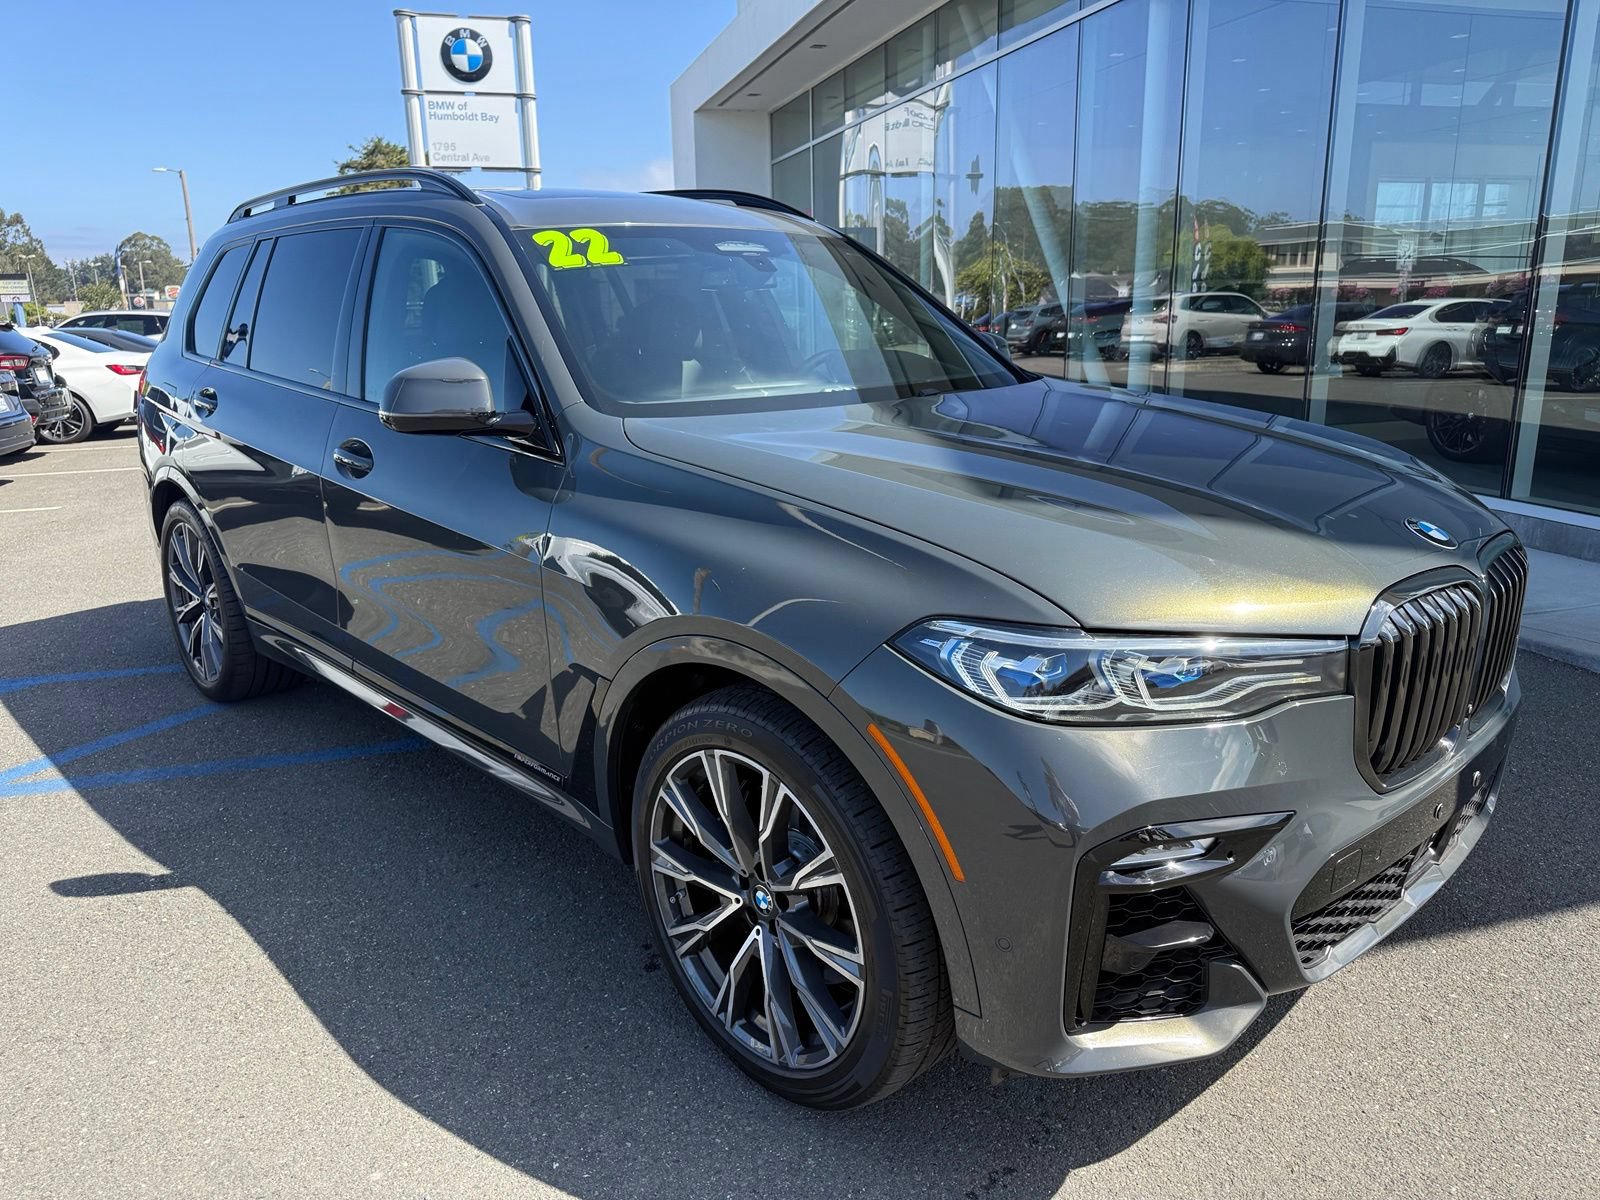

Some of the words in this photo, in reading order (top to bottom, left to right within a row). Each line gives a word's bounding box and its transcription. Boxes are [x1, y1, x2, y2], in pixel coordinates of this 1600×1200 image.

[444, 29, 488, 48] BMW
[428, 100, 456, 111] BMW
[457, 101, 468, 111] of
[428, 111, 479, 121] Humboldt
[480, 112, 500, 124] Bay
[432, 142, 456, 151] 1795
[432, 152, 470, 161] Central
[471, 153, 491, 161] Ave
[532, 228, 624, 270] 22
[703, 719, 753, 738] ZERO
